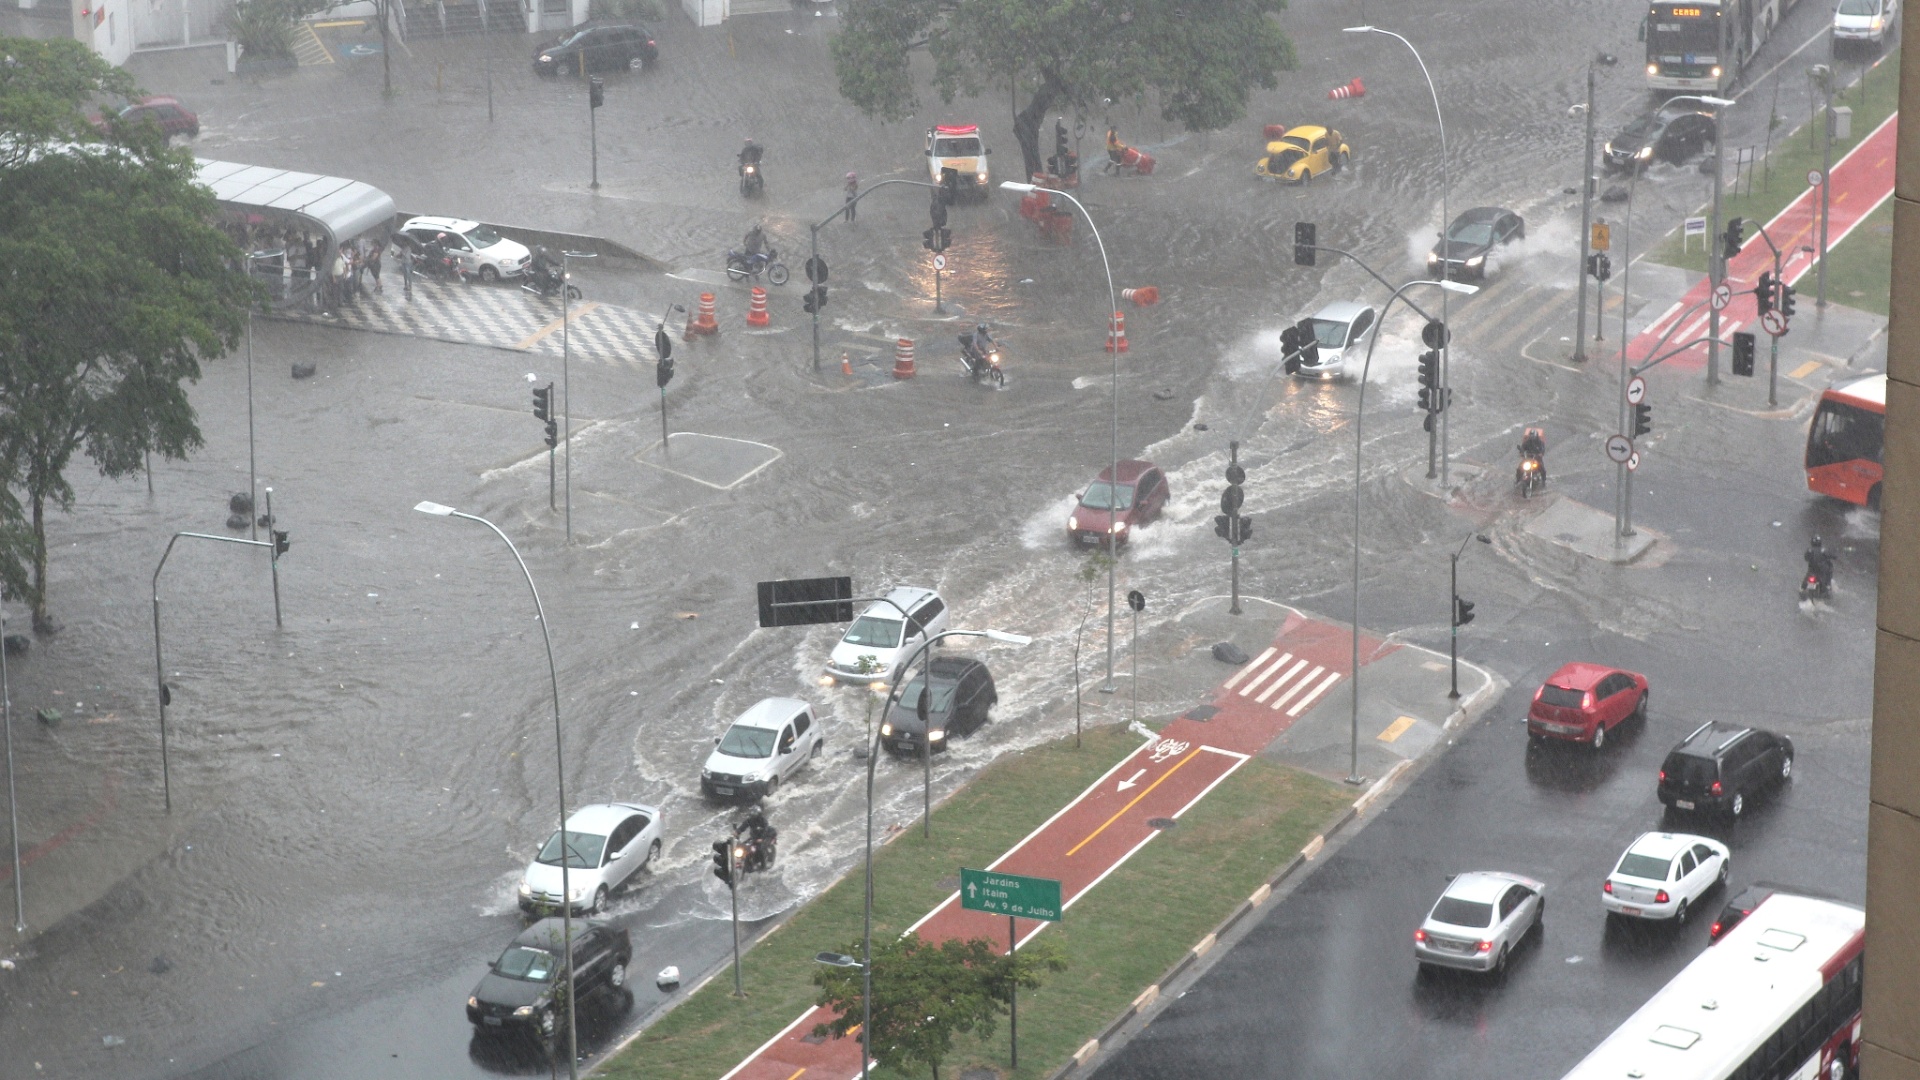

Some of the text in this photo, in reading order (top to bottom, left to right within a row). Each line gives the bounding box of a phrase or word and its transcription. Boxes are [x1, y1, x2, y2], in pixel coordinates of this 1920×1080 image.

[1673, 8, 1700, 16] CEASA
[983, 877, 1020, 888] Jardins
[983, 888, 1008, 899] Itaim
[984, 900, 998, 909] Av.
[1002, 902, 1008, 910] 9
[1028, 906, 1054, 917] Julho
